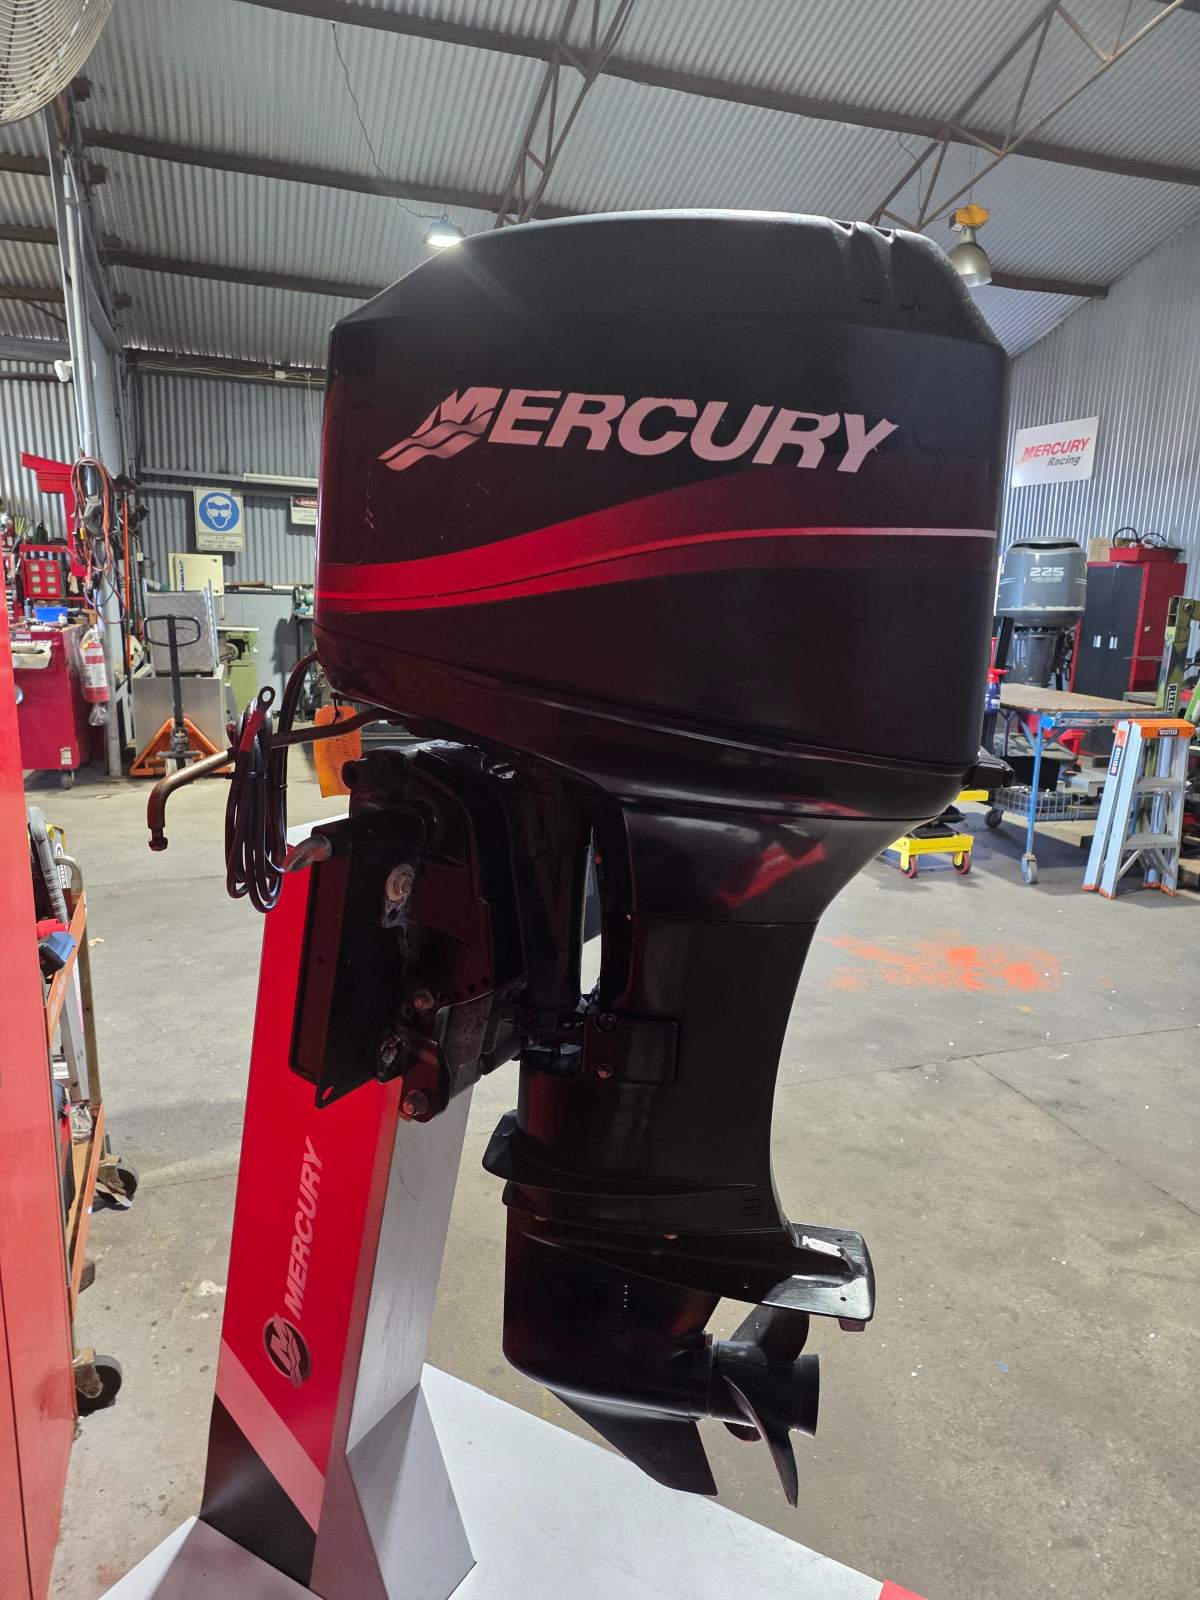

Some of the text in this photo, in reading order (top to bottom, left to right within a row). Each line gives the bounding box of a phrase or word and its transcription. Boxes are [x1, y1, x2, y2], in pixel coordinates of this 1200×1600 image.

[378, 386, 899, 472] MERCURY
[1018, 438, 1091, 462] MERCURY
[1047, 455, 1081, 467] Racing
[1029, 566, 1065, 577] 225
[284, 1135, 324, 1320] MERCURY
